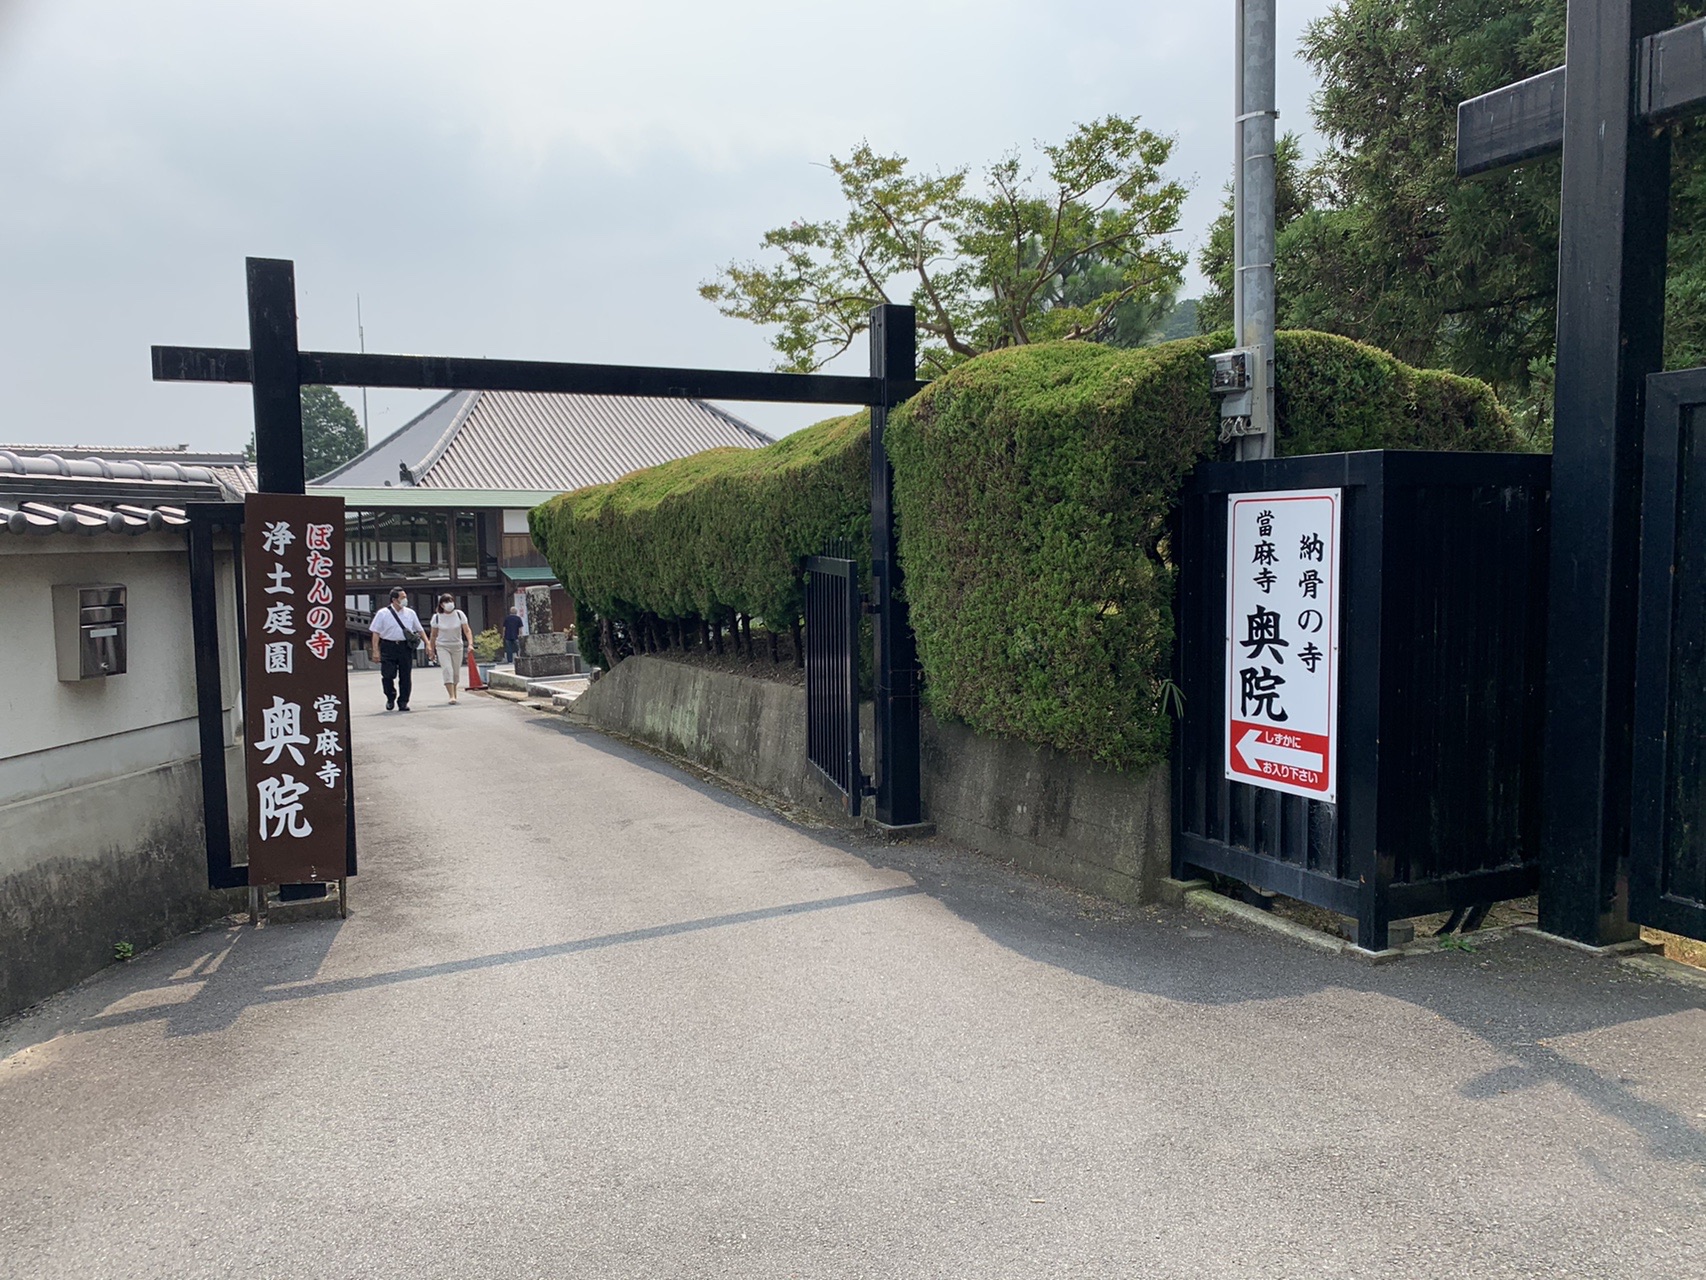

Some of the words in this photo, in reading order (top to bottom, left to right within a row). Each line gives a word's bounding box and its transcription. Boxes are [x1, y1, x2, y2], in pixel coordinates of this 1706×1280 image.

[262, 521, 296, 674] 浄土庭園
[305, 522, 334, 660] ぼたんの寺
[1252, 510, 1279, 594] 當麻寺
[1297, 532, 1324, 673] 納骨の寺
[313, 694, 343, 789] 當麻寺
[1263, 762, 1318, 783] お入り下さい
[1265, 731, 1301, 748] しずかに
